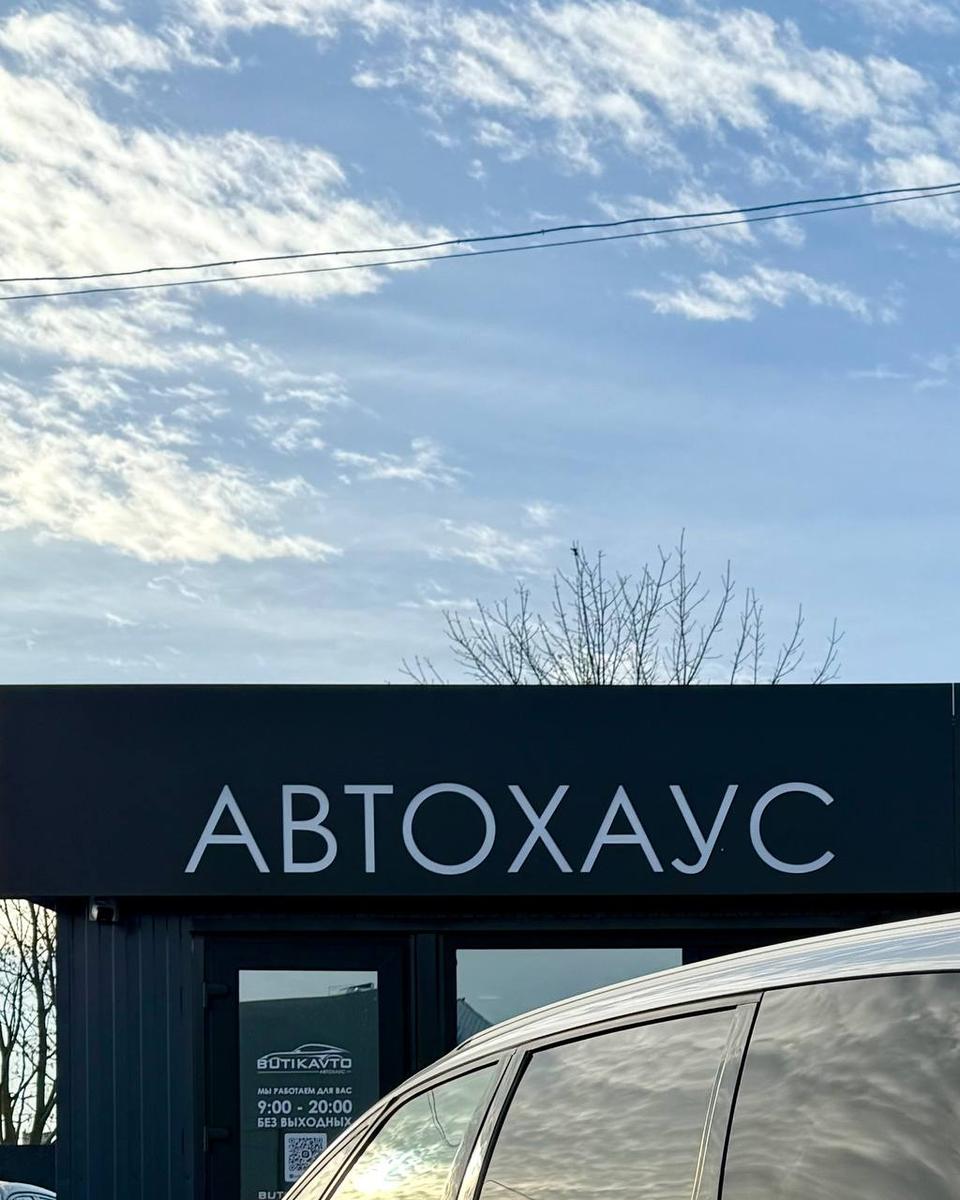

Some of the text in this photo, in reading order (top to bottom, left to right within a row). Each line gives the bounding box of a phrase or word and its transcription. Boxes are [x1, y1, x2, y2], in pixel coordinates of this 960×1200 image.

[183, 781, 836, 876] АВТОХАУС
[257, 1058, 352, 1070] BUTIKAVTO
[257, 1086, 352, 1095] МЫ РАБОТАЕМ ДЛЯ ВАС
[257, 1099, 292, 1115] 9:00
[308, 1099, 353, 1114] 20:00
[257, 1116, 352, 1129] БЕЗ ВЫХОДНЫХ
[258, 1190, 286, 1200] BUT
